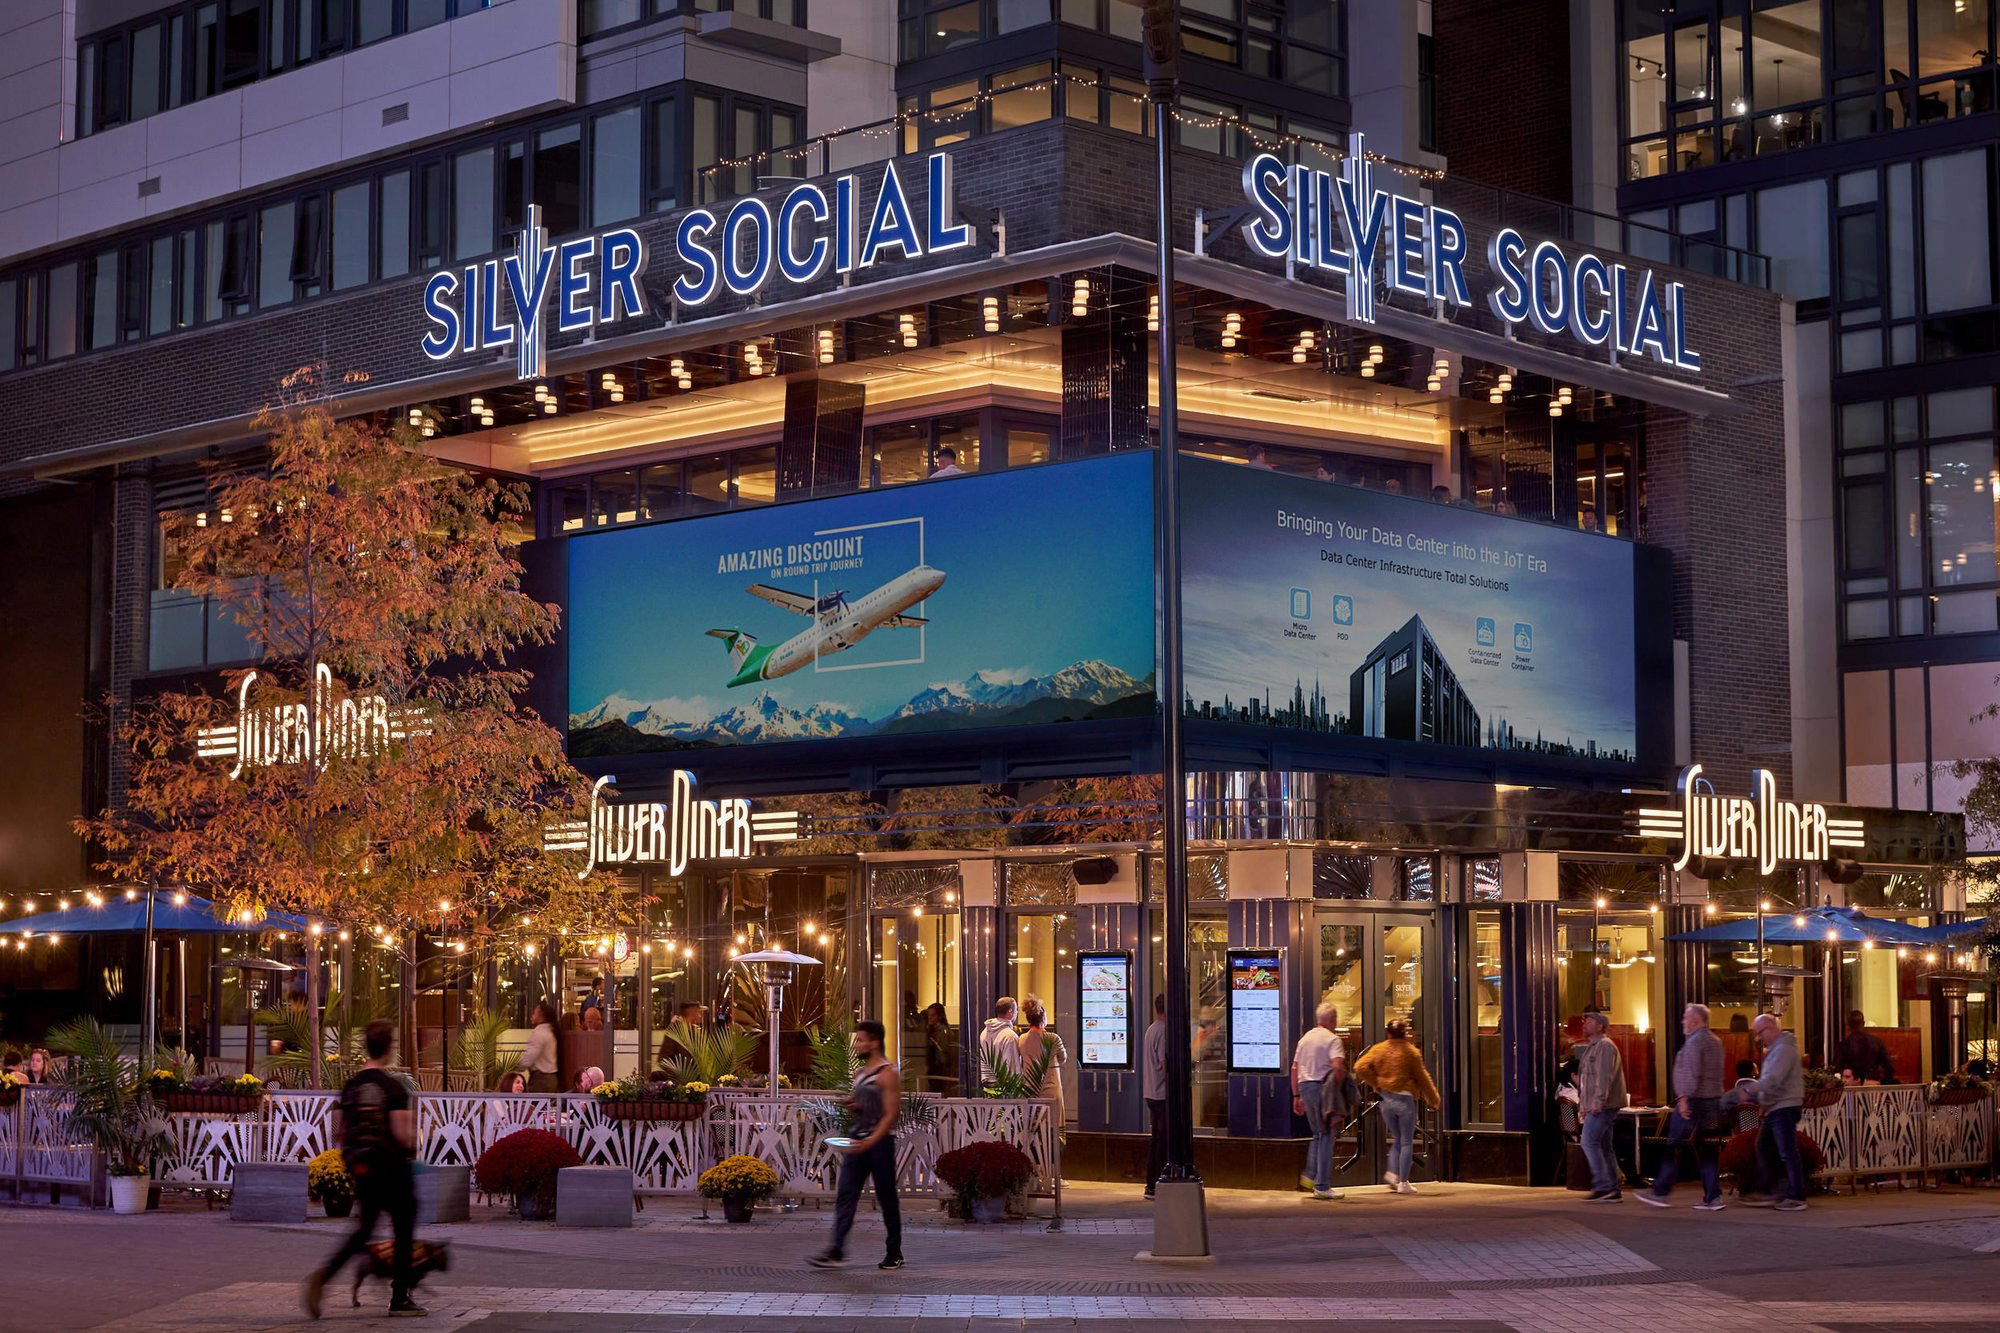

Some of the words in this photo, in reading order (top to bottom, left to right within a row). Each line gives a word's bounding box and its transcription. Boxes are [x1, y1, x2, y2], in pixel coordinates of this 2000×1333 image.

[421, 203, 646, 380] SILVER
[673, 152, 973, 306] SOCIAL
[1243, 132, 1472, 325] SILVER
[1490, 228, 1701, 371] SOCIAL
[717, 547, 783, 574] AMAZING
[787, 535, 864, 565] DISCOUNT
[1277, 509, 1333, 539] Bringing
[1337, 520, 1368, 541] Your
[1372, 527, 1402, 548] Data
[1406, 533, 1449, 556] Center
[1452, 541, 1477, 561] into
[1480, 546, 1501, 565] the
[1504, 550, 1524, 569] IoT
[1528, 554, 1547, 573] Era
[771, 568, 781, 579] ON
[783, 564, 810, 577] ROUND
[811, 562, 828, 574] TRIP
[830, 557, 864, 572] JOURNEY
[1320, 549, 1343, 564] Data
[1345, 553, 1378, 570] Center
[1380, 559, 1442, 581] Infrastructure
[1445, 570, 1467, 585] Total
[1469, 574, 1510, 593] Solutions
[1283, 629, 1297, 638] Data
[1298, 631, 1317, 641] Center
[1292, 622, 1308, 631] Micro
[1470, 656, 1483, 665] Data
[578, 775, 667, 879] SILVER
[670, 769, 751, 876] DINER
[1673, 764, 1758, 871] SILVER
[1760, 769, 1829, 876] DINER
